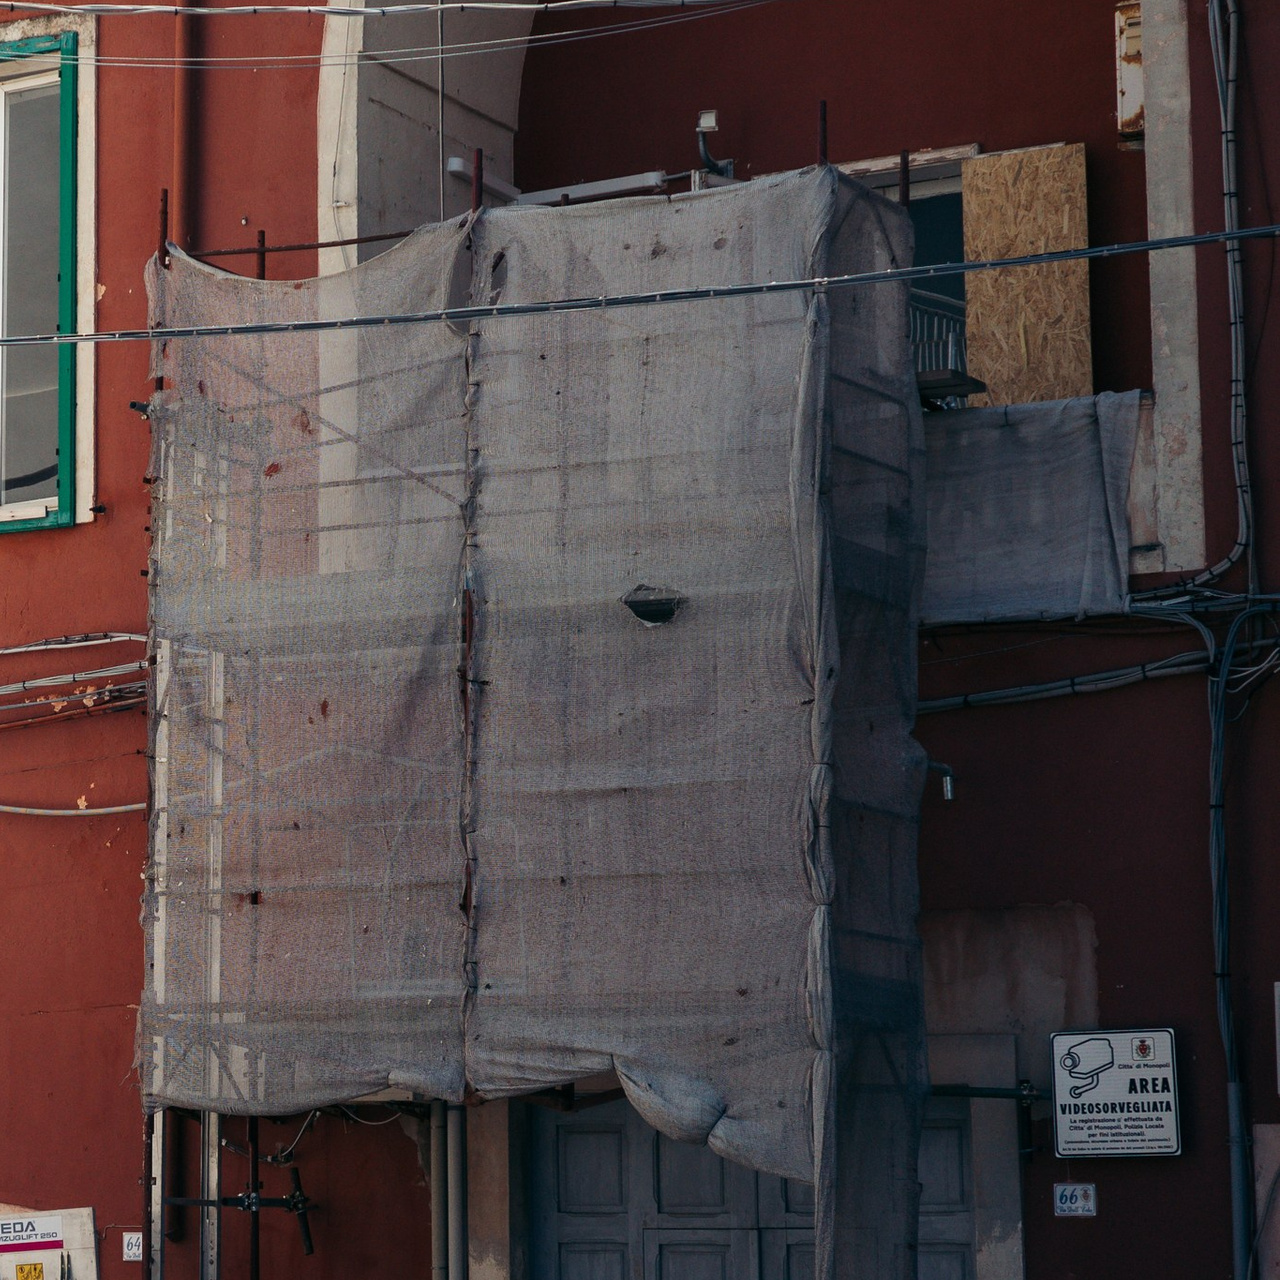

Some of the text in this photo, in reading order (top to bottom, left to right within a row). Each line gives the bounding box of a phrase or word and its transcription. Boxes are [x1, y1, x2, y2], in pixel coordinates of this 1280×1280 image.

[1143, 1062, 1170, 1070] Monopoli
[1128, 1077, 1171, 1094] AREA
[1060, 1101, 1173, 1115] VIDEOSORVEGLIATA
[1059, 1187, 1078, 1205] 66
[40, 1231, 58, 1239] 250
[126, 1236, 141, 1251] 64
